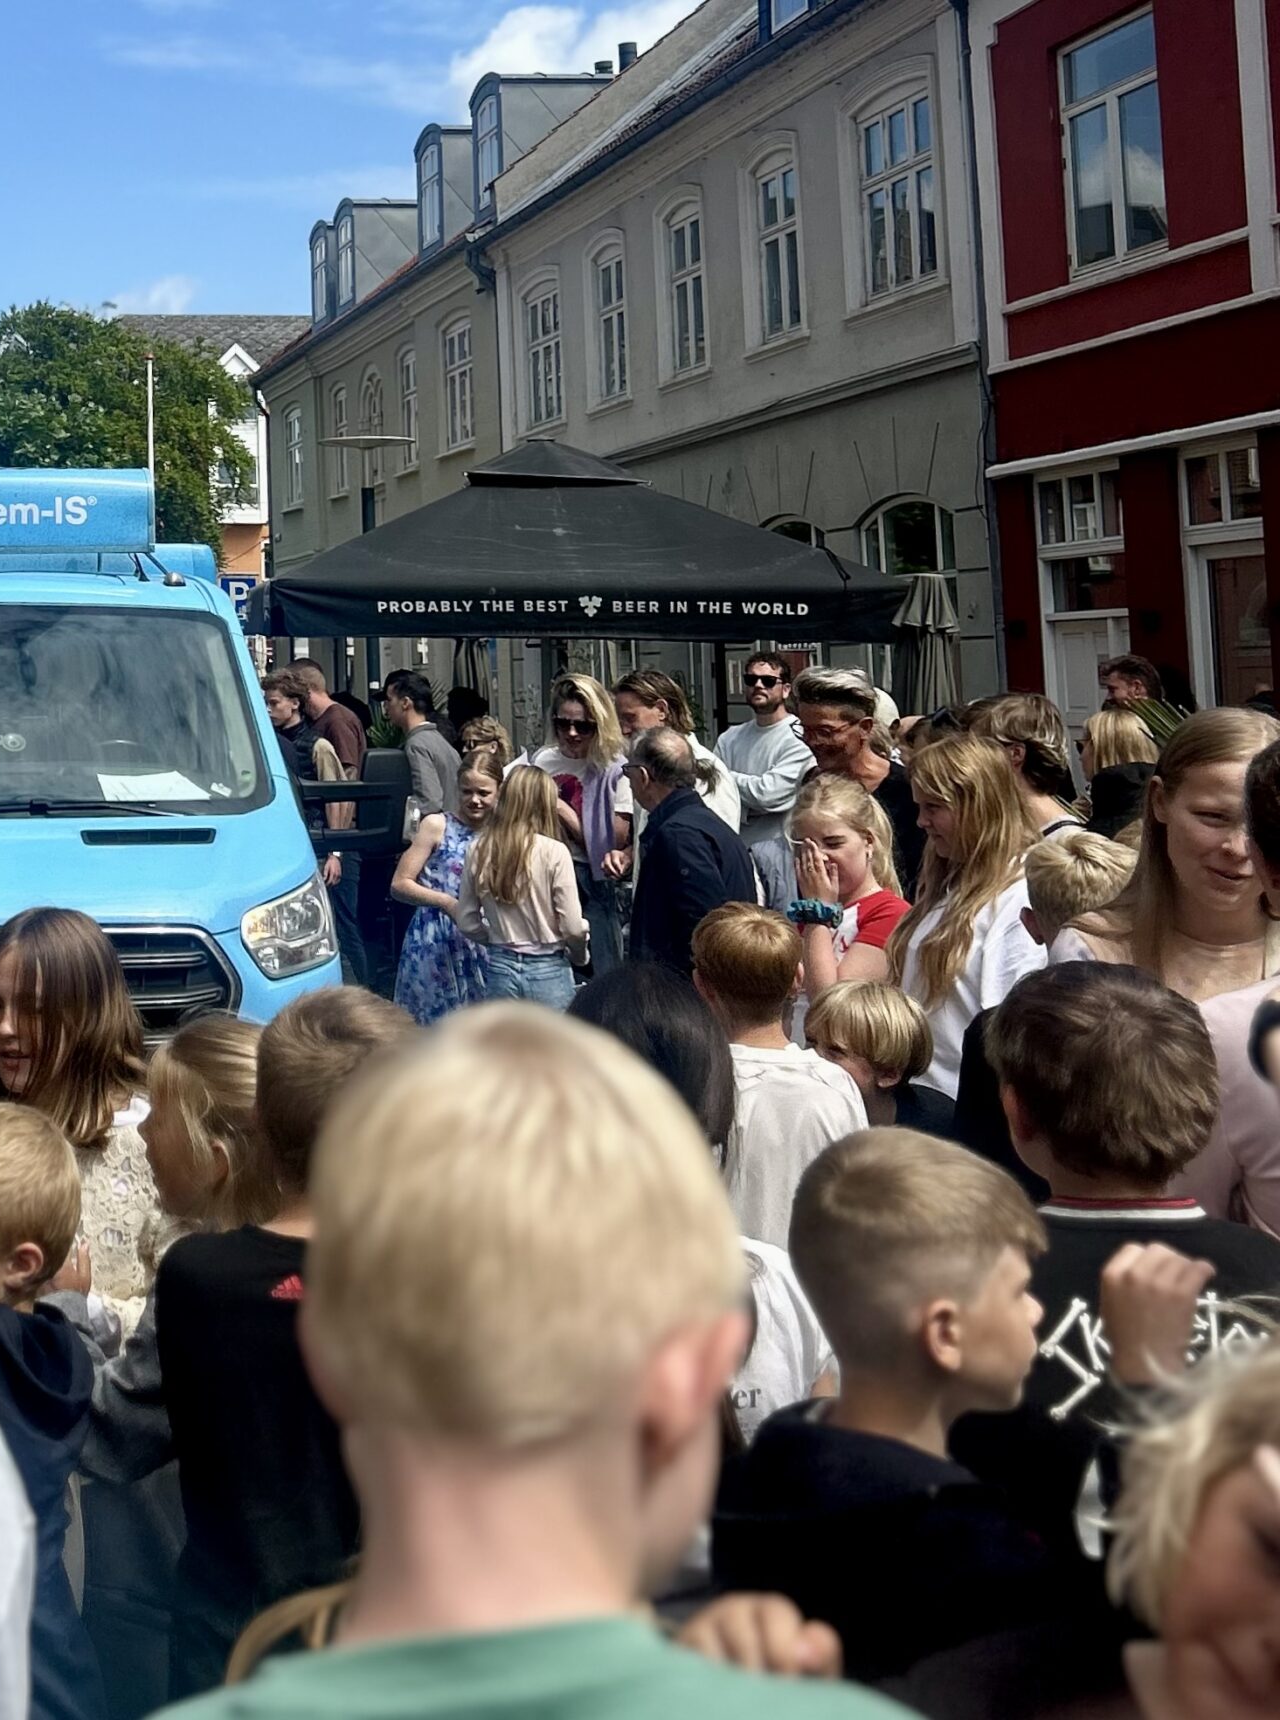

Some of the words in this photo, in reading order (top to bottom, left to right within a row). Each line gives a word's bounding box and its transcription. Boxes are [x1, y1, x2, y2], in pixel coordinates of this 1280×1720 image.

[377, 600, 472, 613] PROBABLY
[480, 600, 515, 612] THE
[523, 600, 569, 612] BEST
[612, 600, 659, 613] BEER
[670, 601, 688, 613] IN
[697, 601, 732, 614] THE
[741, 602, 809, 615] WORLD
